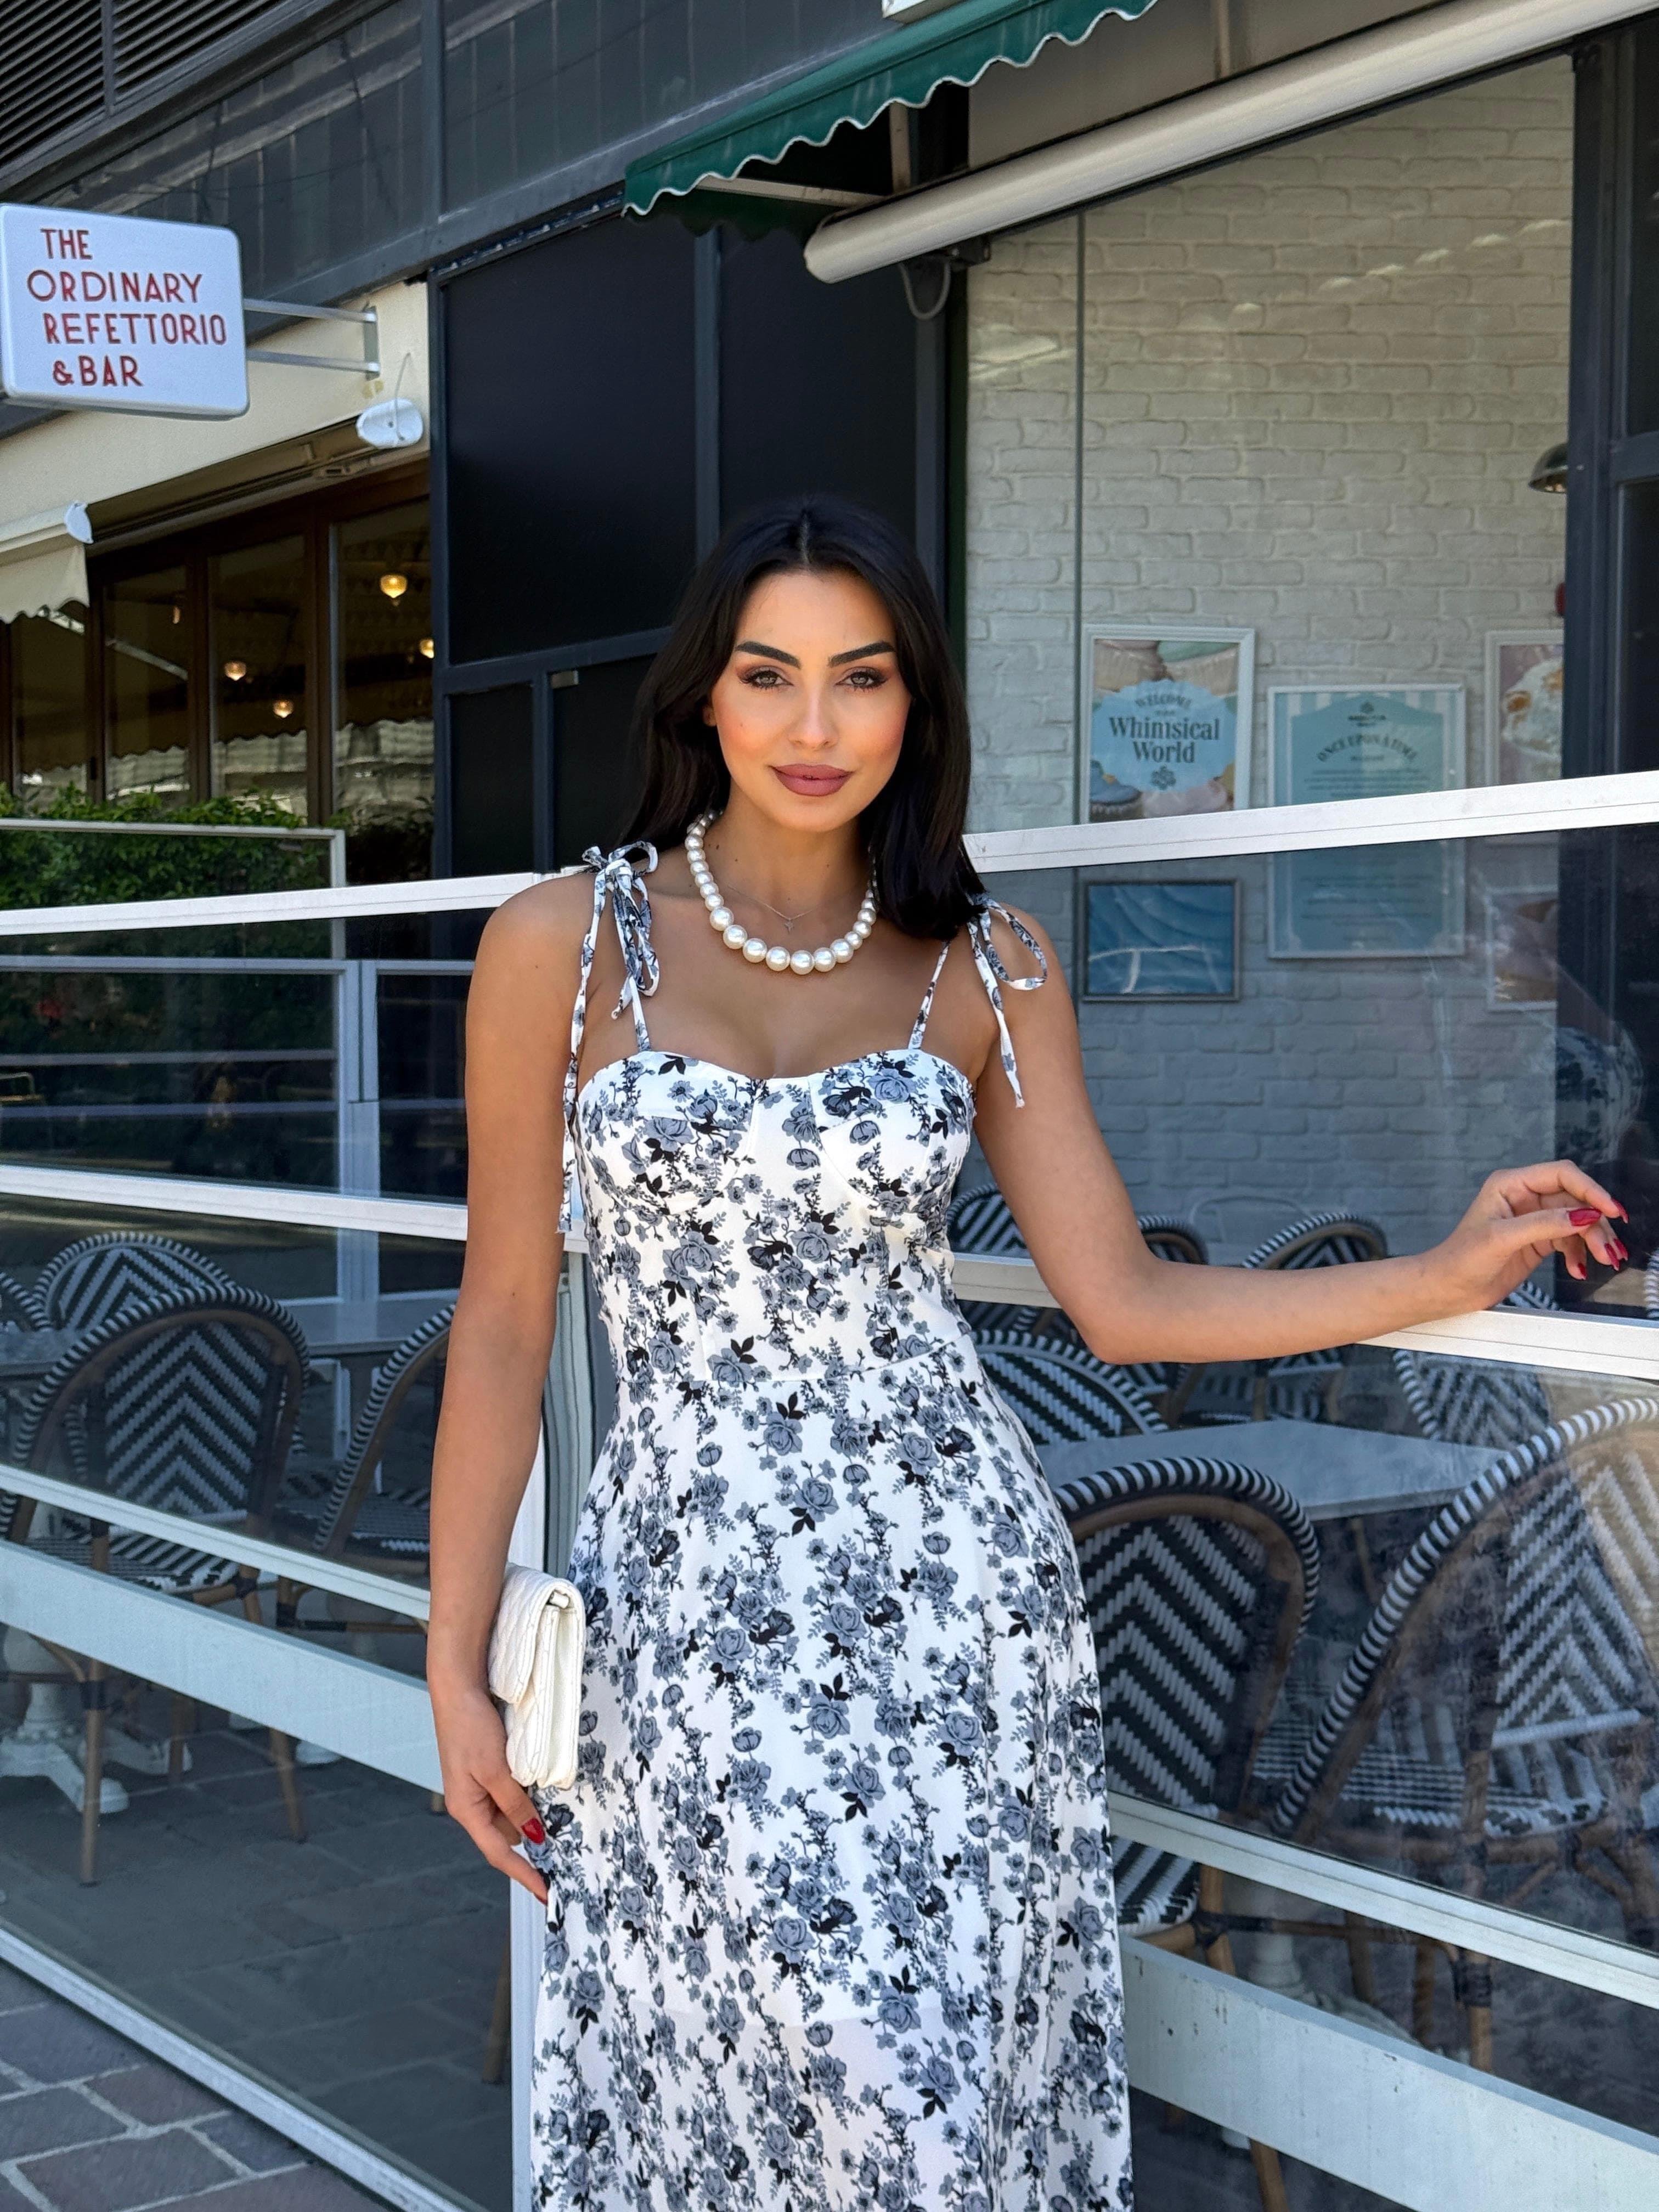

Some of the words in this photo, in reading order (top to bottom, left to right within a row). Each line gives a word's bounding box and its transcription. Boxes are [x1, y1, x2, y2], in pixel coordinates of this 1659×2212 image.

[41, 228, 92, 259] THE
[27, 269, 202, 303] ORDINARY
[43, 313, 227, 345] REFETTORIO
[1109, 716, 1220, 740] Whimsical
[1132, 741, 1195, 763] World
